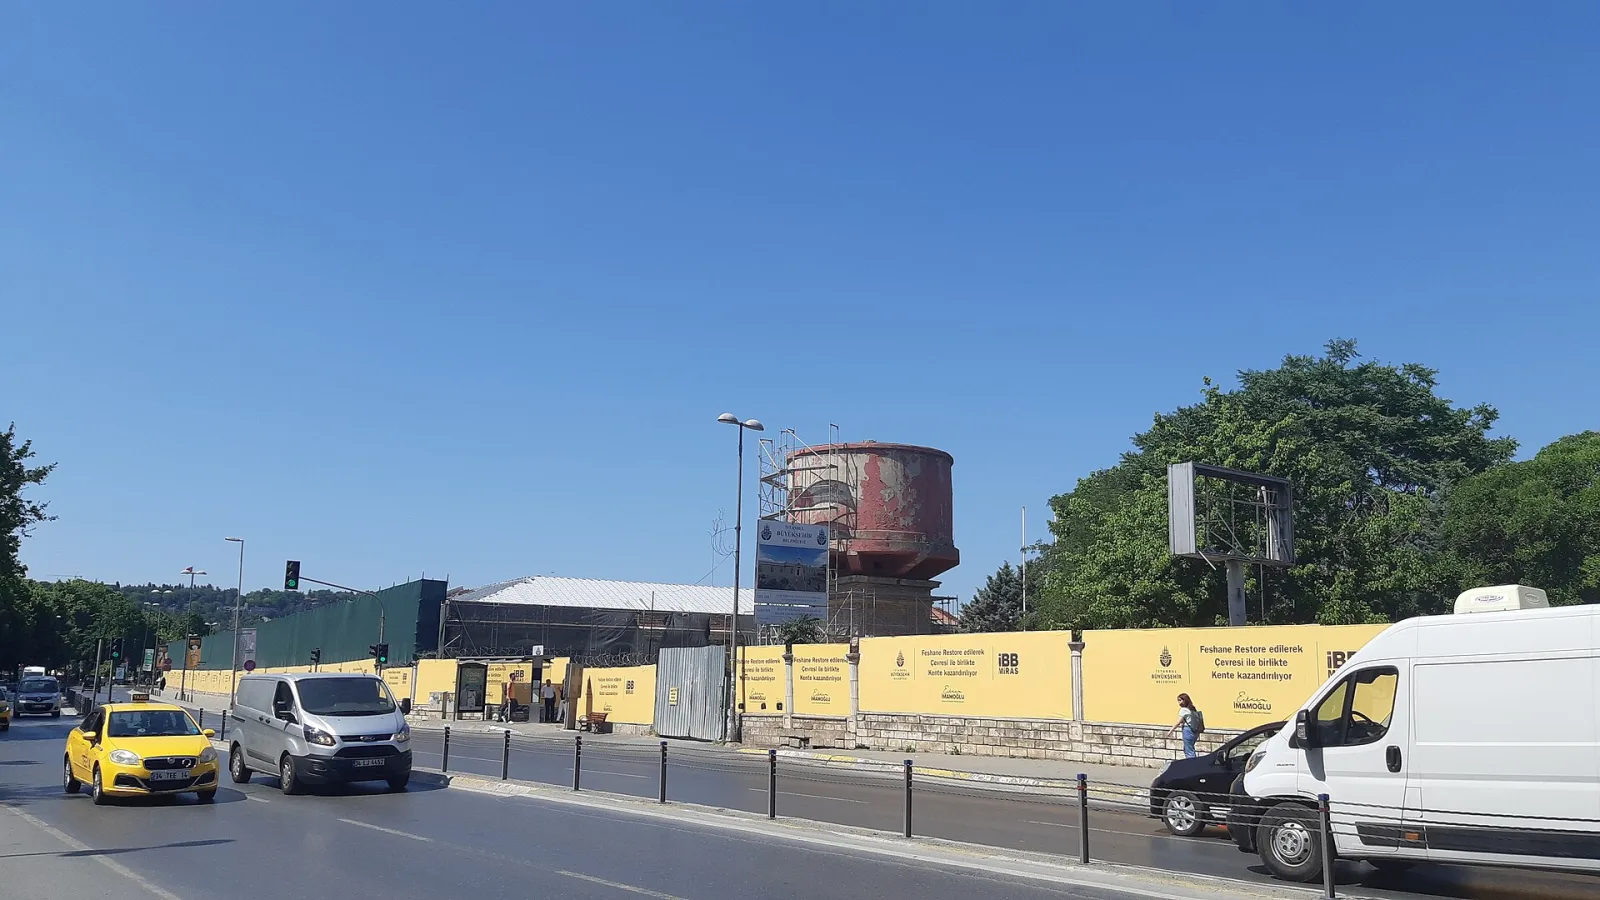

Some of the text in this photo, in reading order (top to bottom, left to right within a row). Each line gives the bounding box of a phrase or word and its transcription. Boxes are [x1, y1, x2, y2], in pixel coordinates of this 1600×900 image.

[1200, 644, 1303, 654] Feshane Restore edilerek
[1215, 658, 1288, 668] Çevresi ile birlikte
[1212, 671, 1292, 682] Kente kazandırılıyor
[1234, 701, 1271, 710] İMAMOĞLU
